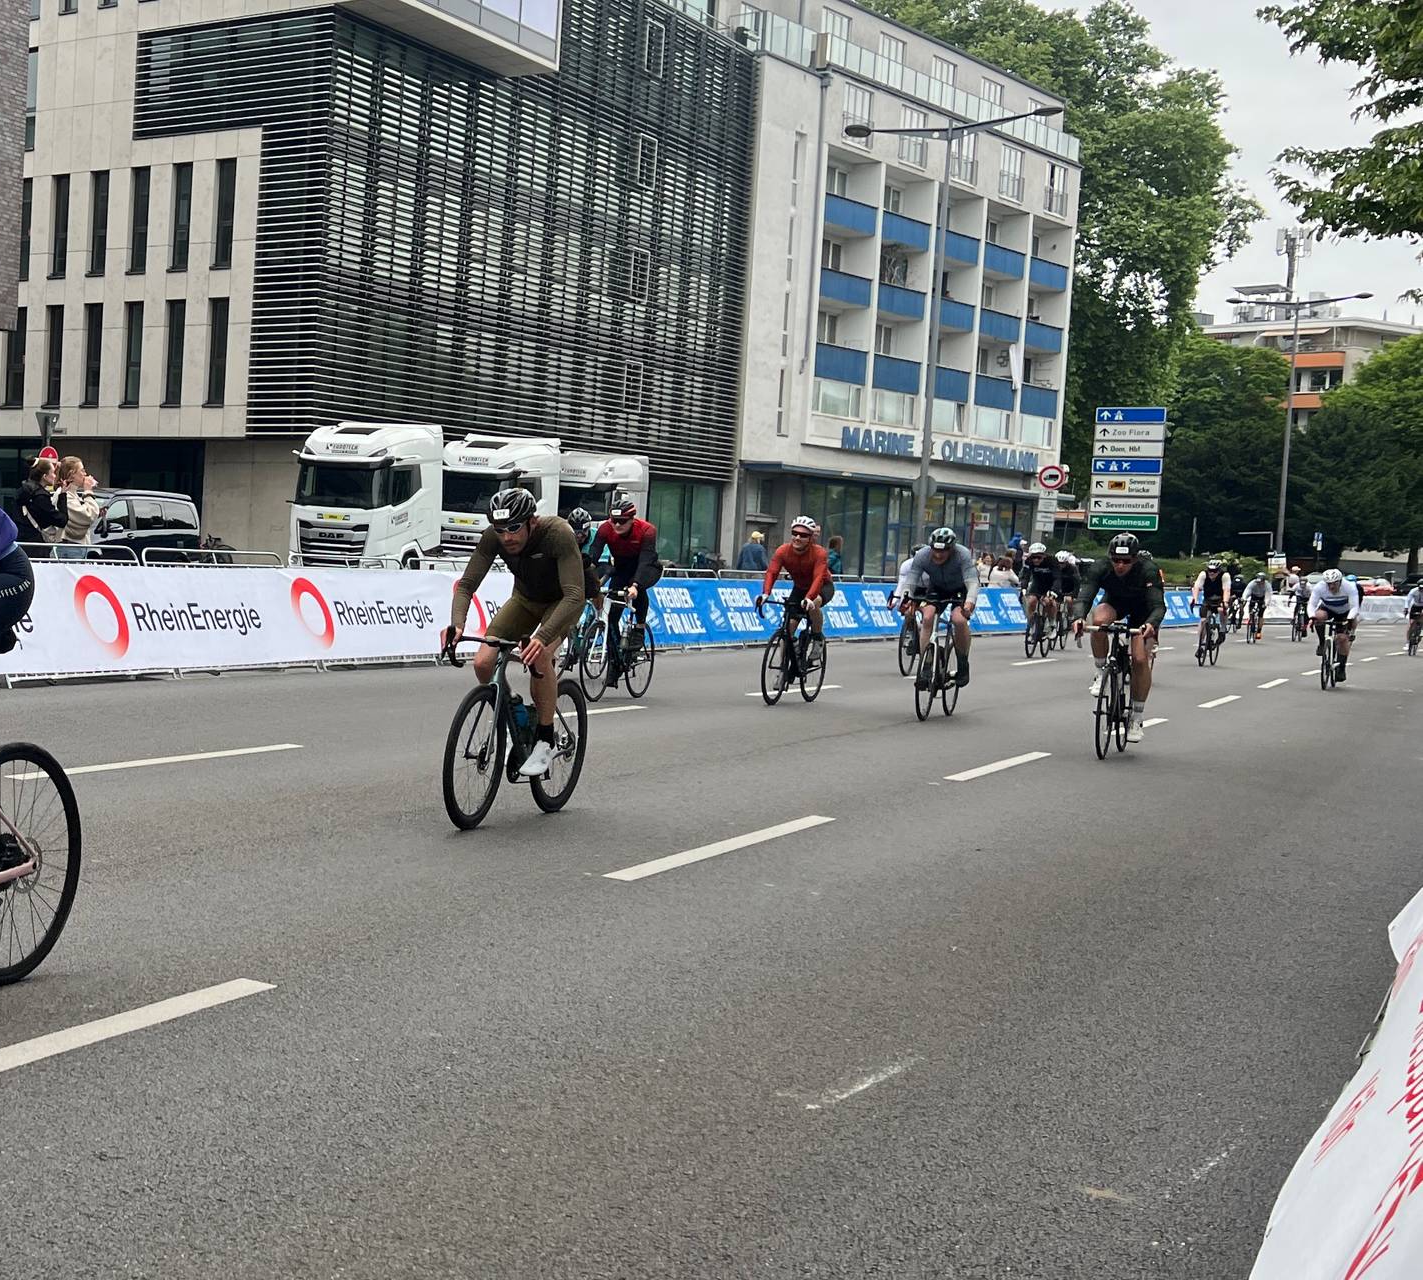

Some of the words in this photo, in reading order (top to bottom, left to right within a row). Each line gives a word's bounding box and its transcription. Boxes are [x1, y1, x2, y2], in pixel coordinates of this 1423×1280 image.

[841, 426, 915, 457] MARINE
[941, 440, 1039, 472] OLBERMANN
[1102, 518, 1150, 526] Koelnmesse
[130, 602, 262, 636] RheinEnergie
[333, 600, 434, 630] RheinEnergie
